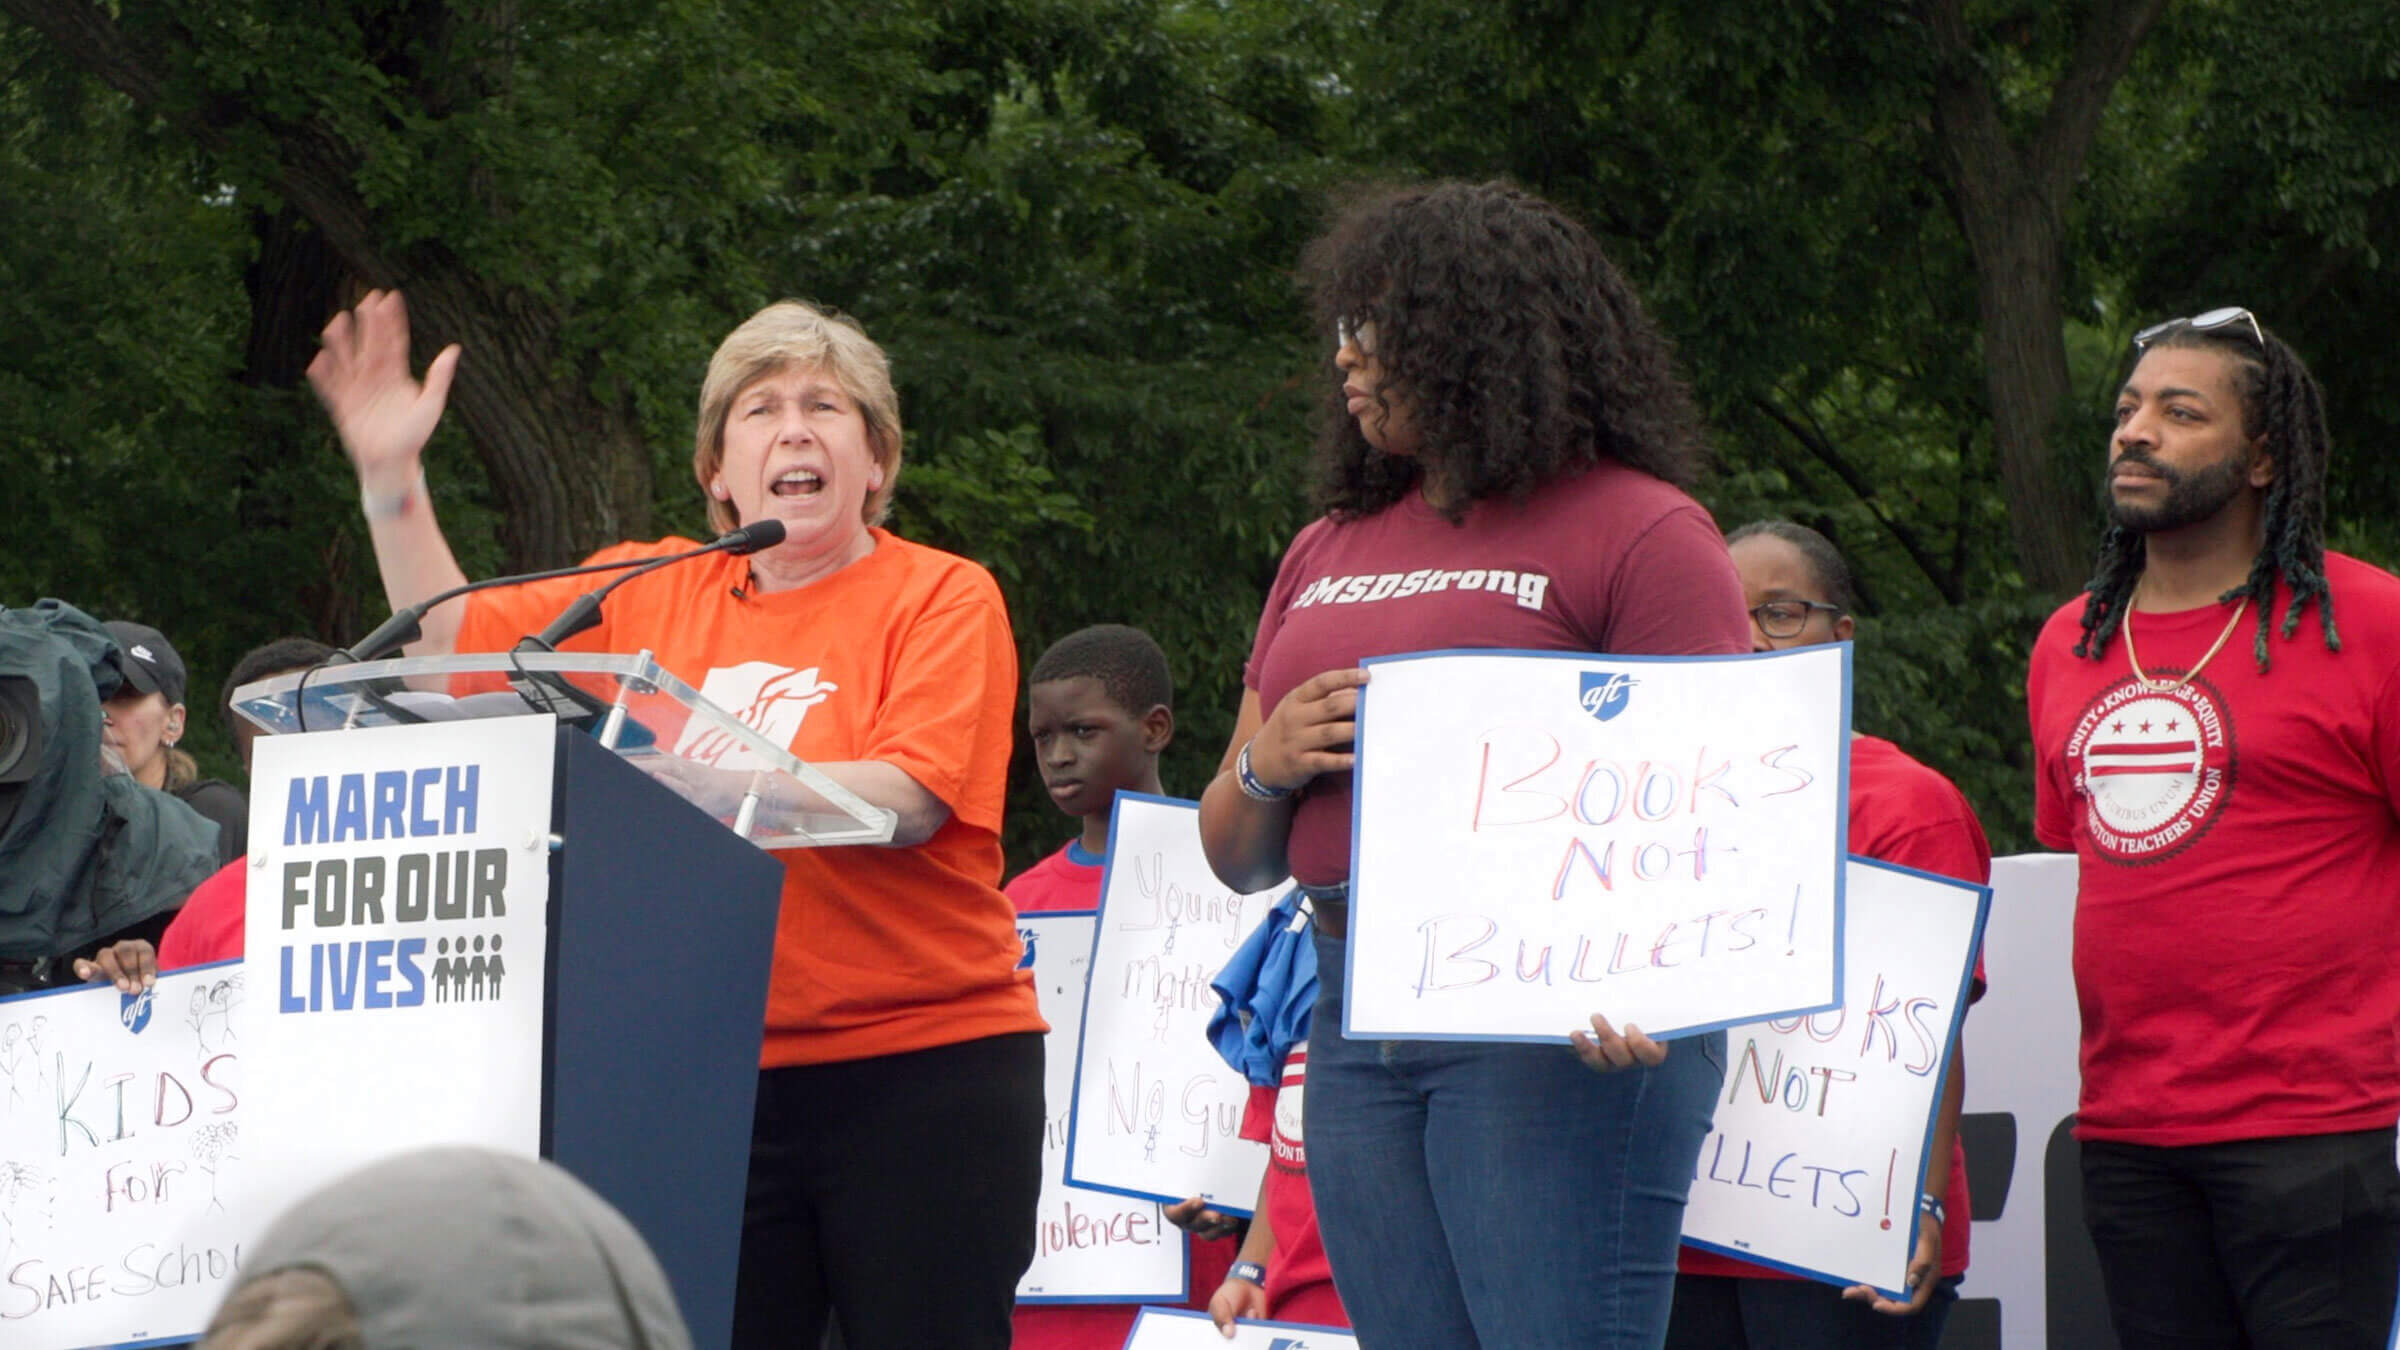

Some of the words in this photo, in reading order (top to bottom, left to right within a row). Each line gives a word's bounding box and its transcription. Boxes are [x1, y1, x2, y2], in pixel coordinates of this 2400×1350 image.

[1292, 568, 1549, 611] #MSDStrong
[1582, 671, 1641, 716] aft
[2067, 710, 2100, 758] UNITY
[2193, 697, 2224, 749] EQUITY
[283, 764, 480, 847] MARCH
[2188, 766, 2223, 819] UNION
[281, 855, 386, 930] FOR
[395, 847, 507, 923] OUR
[1119, 852, 1244, 950] Young
[279, 937, 427, 1013] LIVES
[56, 1051, 238, 1157] KIDS
[1728, 1038, 1857, 1117] NOT
[0, 1259, 105, 1320] SAFE
